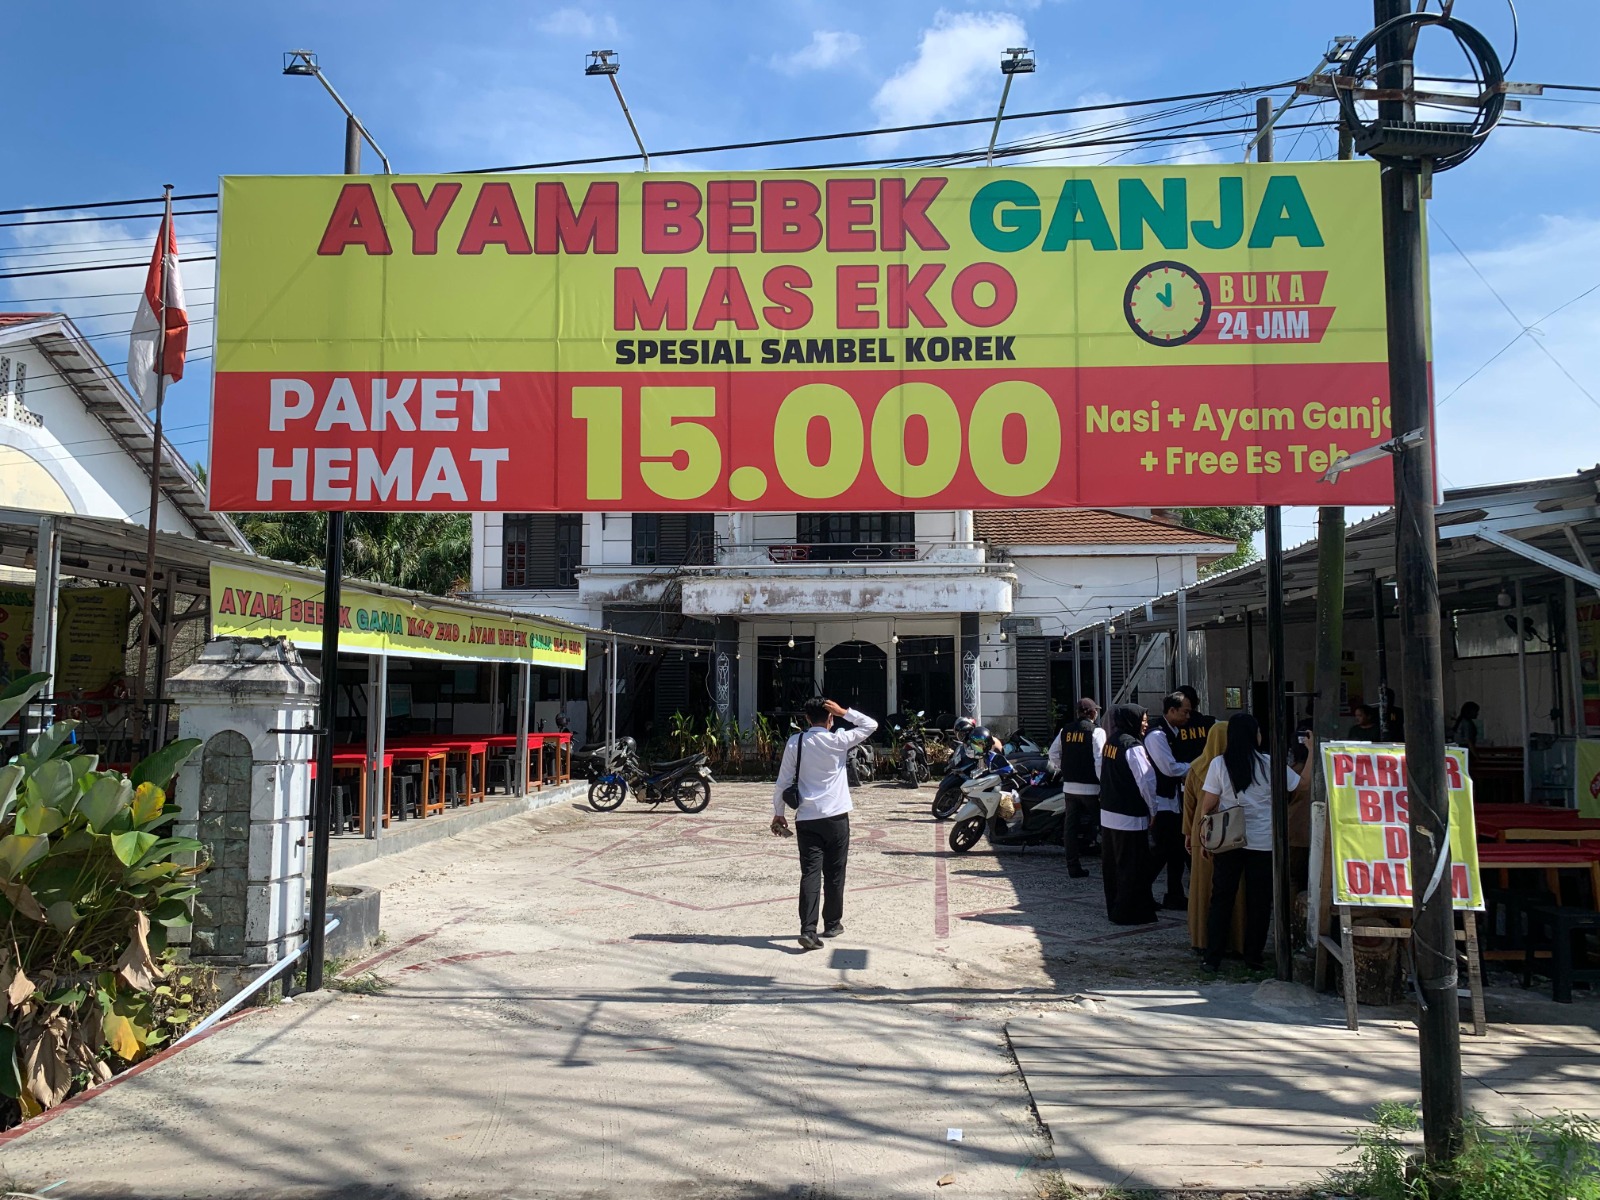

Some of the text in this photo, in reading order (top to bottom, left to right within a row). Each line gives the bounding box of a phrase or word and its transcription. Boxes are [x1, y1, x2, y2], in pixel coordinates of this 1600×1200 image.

[317, 174, 1324, 255] AYAM BEBEK GANJA
[613, 261, 1018, 331] MAS EKO
[1219, 273, 1307, 305] BUKA
[1217, 310, 1310, 341] 24 JAM
[615, 335, 1016, 366] SPESIAL SAMBEL KOREK
[268, 377, 501, 432] PAKET
[1086, 400, 1160, 434] Nasi
[1167, 408, 1185, 429] +
[1193, 403, 1291, 438] Ayam
[571, 380, 1062, 502] 15.000
[1140, 450, 1159, 472] +
[1166, 446, 1235, 475] Free
[1247, 445, 1281, 474] Es
[256, 447, 510, 502] HEMAT
[218, 587, 284, 621] AYAM
[290, 598, 352, 629] BEBK
[356, 608, 404, 635] GANJA
[467, 626, 496, 645] AYAM
[1066, 731, 1085, 744] BNN
[1180, 726, 1207, 741] BNN
[1333, 753, 1463, 789] PARR
[1346, 861, 1470, 899] DALM
